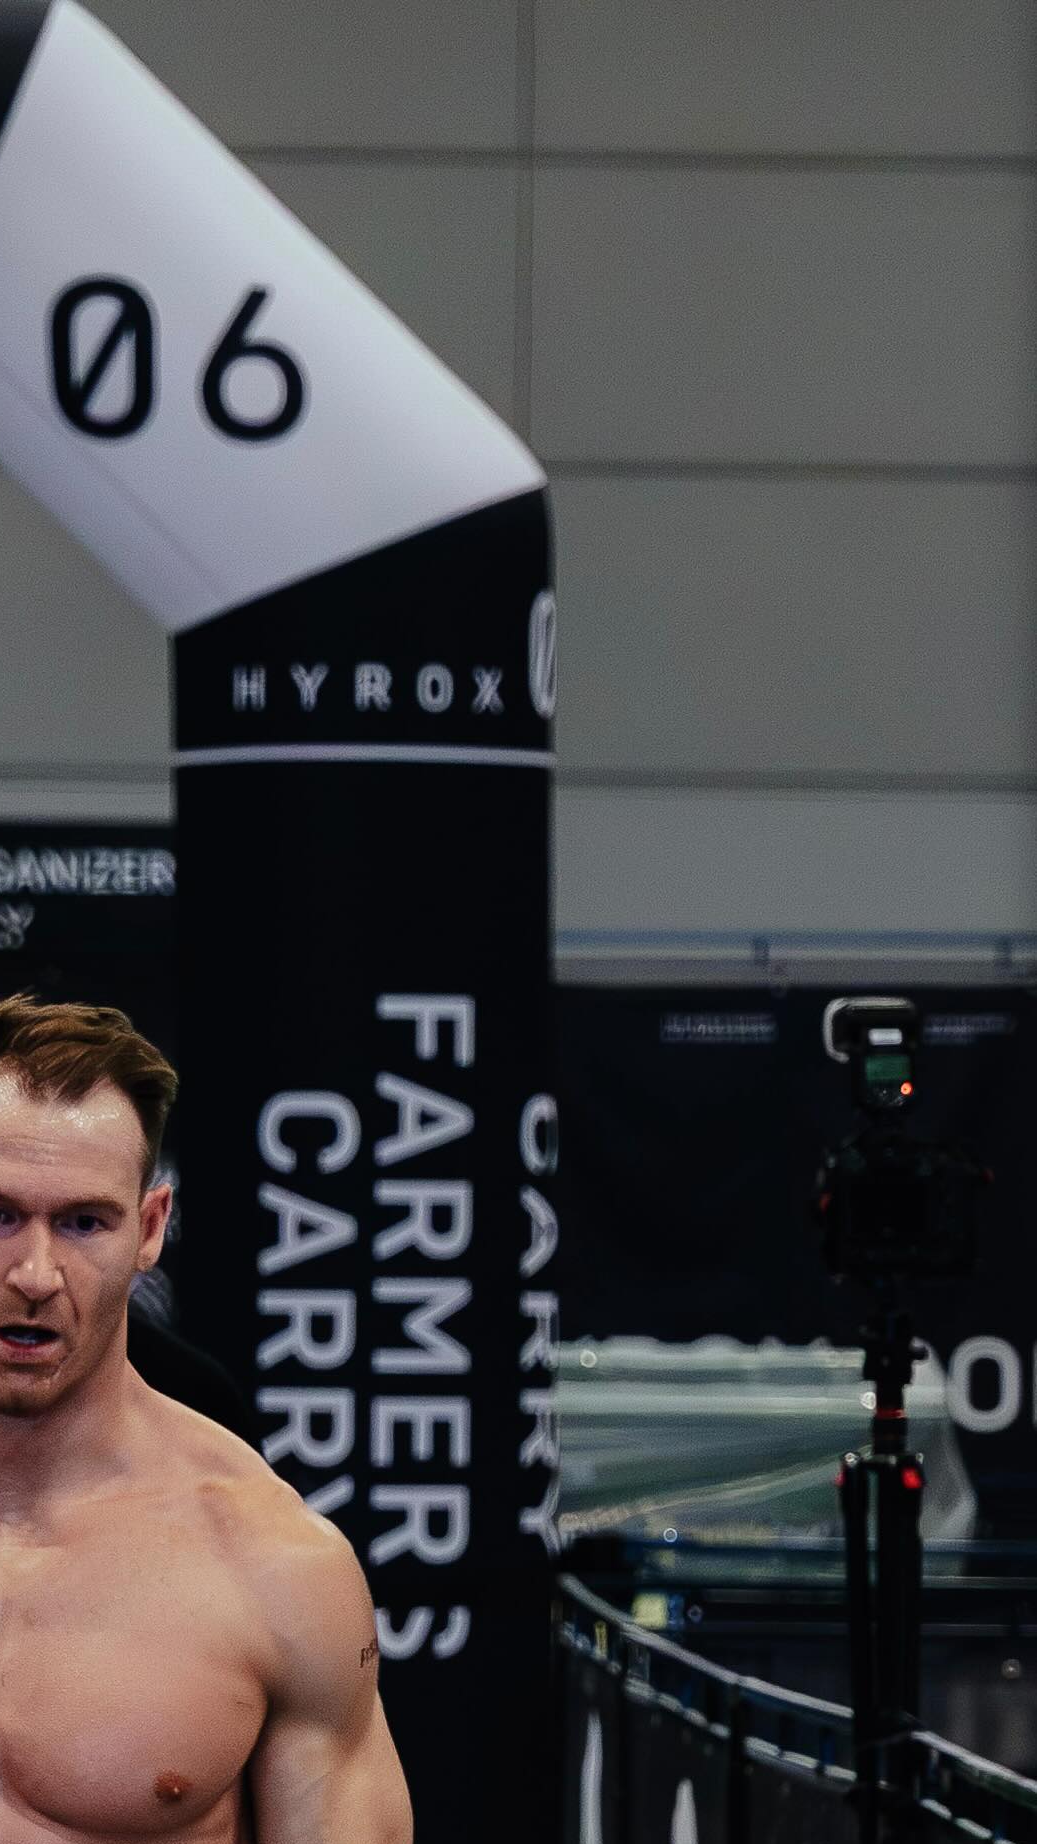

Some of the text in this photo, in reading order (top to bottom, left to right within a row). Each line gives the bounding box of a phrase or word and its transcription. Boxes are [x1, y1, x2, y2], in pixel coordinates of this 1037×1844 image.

[48, 273, 310, 443] 06
[232, 662, 505, 714] HYROX
[367, 992, 476, 1661] FARMERS
